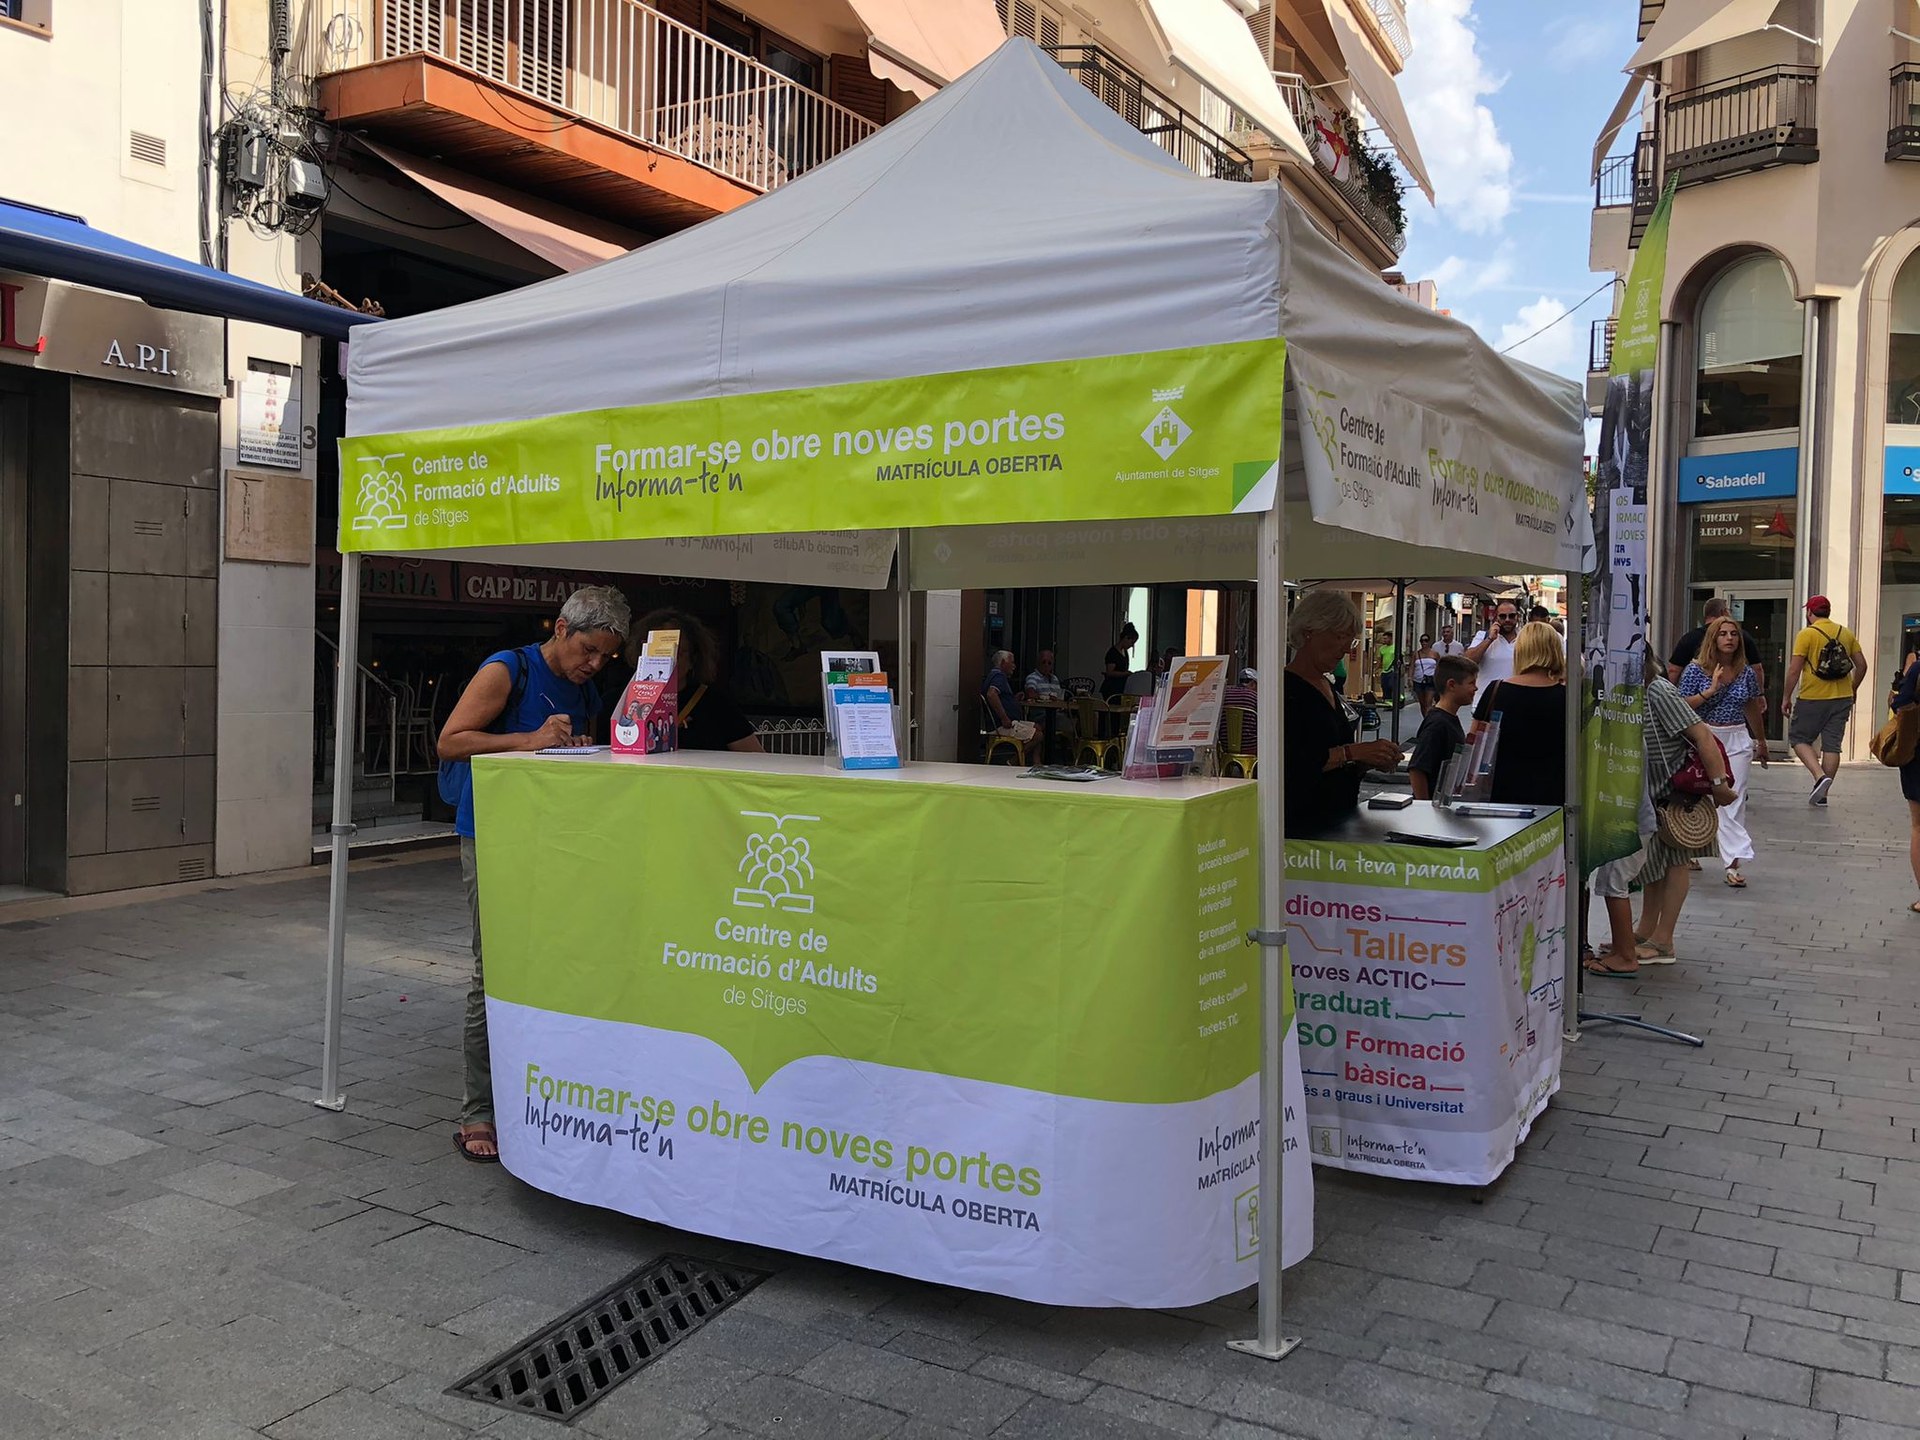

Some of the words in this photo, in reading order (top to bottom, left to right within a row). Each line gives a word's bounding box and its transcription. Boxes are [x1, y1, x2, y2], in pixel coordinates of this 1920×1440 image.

[102, 338, 178, 377] A.P.I.
[302, 425, 317, 450] 3
[1340, 407, 1374, 440] Centre
[595, 440, 742, 473] Formar-se
[751, 429, 822, 462] obre
[833, 424, 933, 456] noves
[943, 409, 1065, 455] portes
[412, 455, 464, 475] Centre
[468, 450, 488, 469] de
[876, 458, 981, 481] MATRÍCULA
[985, 453, 1063, 475] OBERTA
[1115, 469, 1169, 483] Ajuntament
[1172, 468, 1184, 478] de
[1188, 466, 1220, 481] Sitges
[413, 478, 486, 501] Formació
[490, 473, 560, 496] d'Adults
[595, 459, 743, 512] Informa-te'n
[1505, 479, 1534, 506] noves
[1705, 471, 1766, 490] Sabadell
[414, 509, 429, 526] de
[432, 508, 469, 527] Sitges
[467, 575, 511, 599] CAP
[513, 577, 536, 600] DE
[1283, 848, 1320, 870] scull
[1329, 850, 1347, 872] la
[1354, 851, 1397, 877] teva
[1404, 857, 1481, 886] parada
[1285, 894, 1382, 922] diomes
[714, 916, 792, 948] Centre
[798, 928, 828, 953] de
[1346, 928, 1467, 967] Tallers
[661, 941, 771, 979] Formació
[778, 958, 878, 994] d'Adults
[1292, 963, 1350, 982] roves
[1355, 966, 1428, 991] ACTIC
[723, 985, 746, 1006] de
[751, 987, 808, 1017] Sitges
[1297, 1021, 1337, 1048] SO
[1345, 1029, 1465, 1063] Formació
[1345, 1060, 1426, 1091] bàsica
[1322, 1089, 1331, 1098] a
[1335, 1090, 1373, 1105] graus
[1376, 1093, 1381, 1105] i
[1385, 1094, 1465, 1114] Universitat
[524, 1095, 674, 1161] Informa-te'n
[525, 1062, 676, 1127] Formar-se
[687, 1098, 770, 1144] obre
[781, 1120, 894, 1169] noves
[905, 1144, 1042, 1197] portes
[1346, 1134, 1426, 1156] Informa-te'n
[1198, 1154, 1255, 1190] MATRÍCULA
[1346, 1152, 1393, 1166] MATRÍCULA
[1394, 1159, 1426, 1170] OBERTA
[829, 1172, 946, 1215] MATRÍCULA
[951, 1197, 1040, 1232] OBERTA
